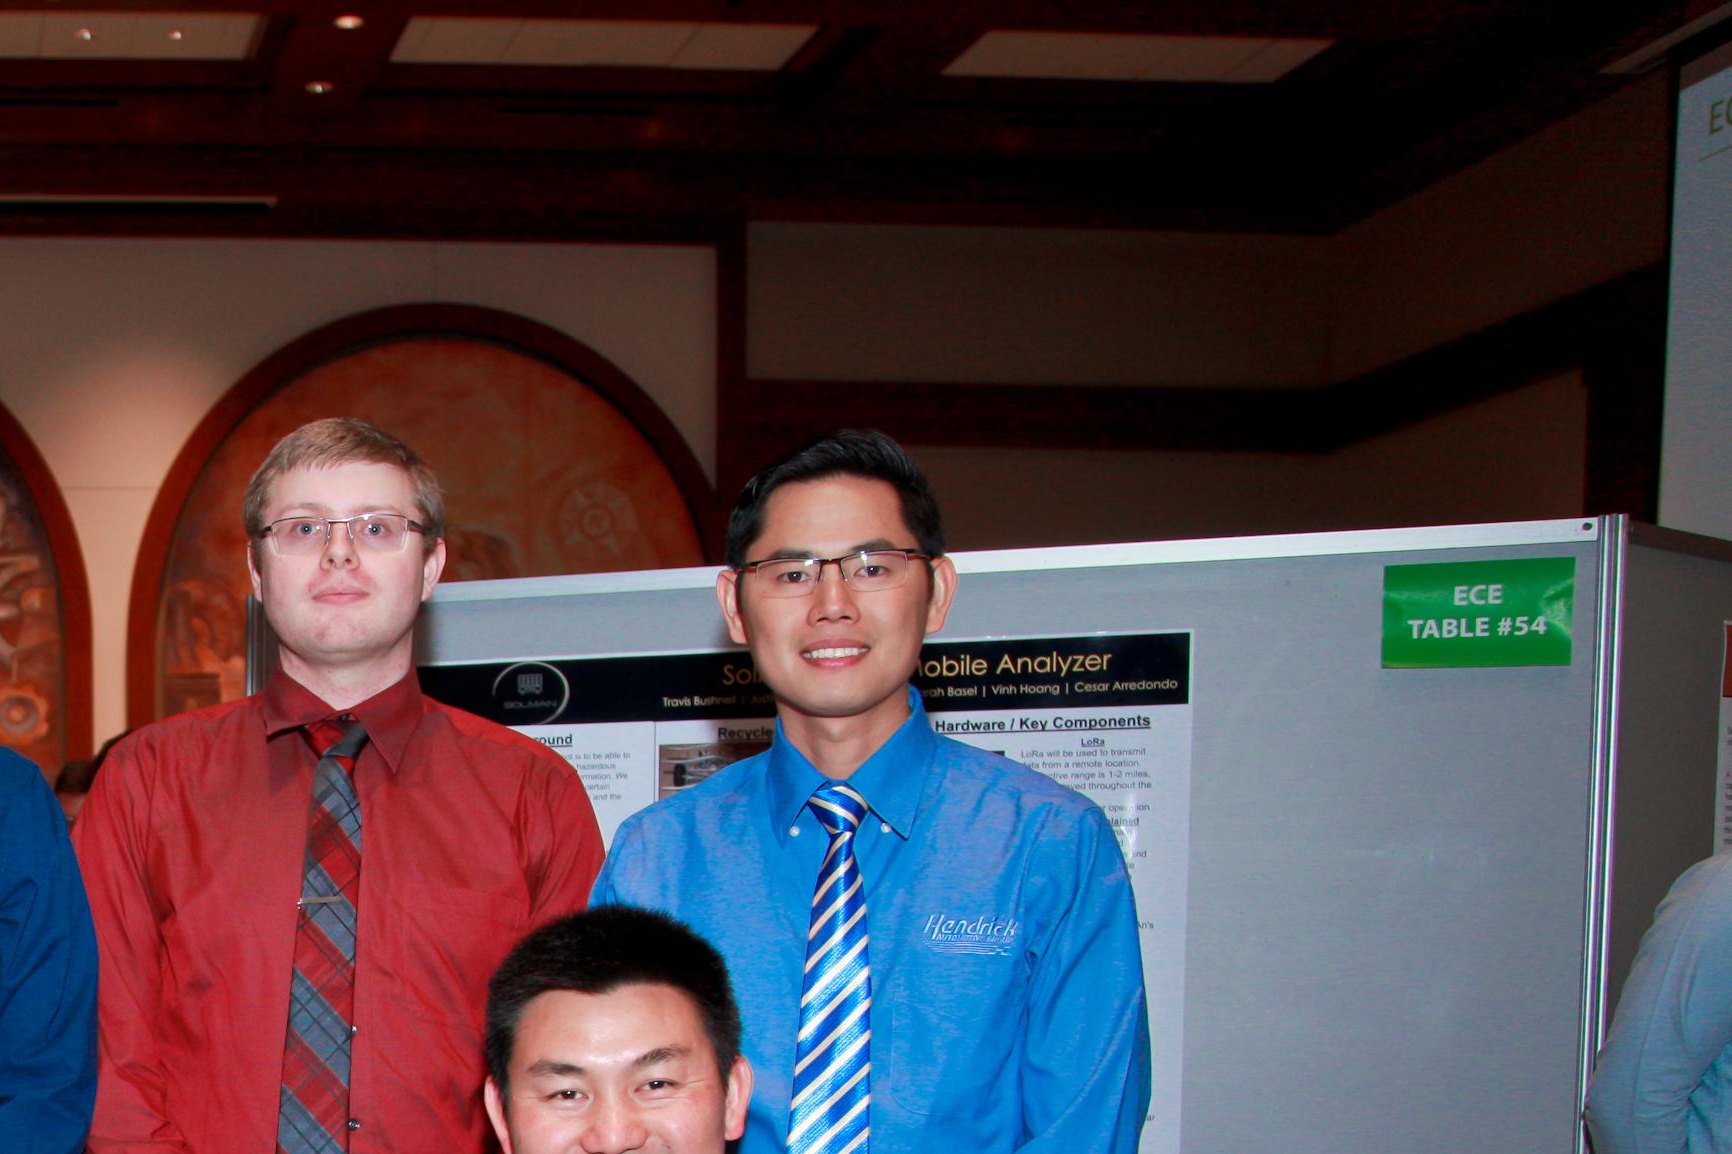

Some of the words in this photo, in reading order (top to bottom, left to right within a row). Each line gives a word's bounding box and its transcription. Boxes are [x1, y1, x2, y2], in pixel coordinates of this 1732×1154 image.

[1453, 584, 1504, 606] ECE
[1407, 618, 1490, 639] TABLE
[1497, 615, 1547, 636] #54
[995, 650, 1112, 677] Analyzer
[661, 696, 691, 708] Travis
[947, 685, 978, 697] Basel
[991, 684, 1017, 696] Vinh
[1019, 683, 1060, 696] Hoang
[1074, 681, 1110, 693] Cesar
[1112, 678, 1178, 692] Arredondo
[935, 719, 1006, 732] Hardware
[1019, 717, 1047, 731] Key
[1053, 715, 1151, 729] Components
[1080, 737, 1106, 747] LoRa
[1021, 750, 1044, 759] LoRa
[1046, 750, 1060, 758] will
[1063, 749, 1073, 758] be
[1076, 749, 1097, 757] used
[1099, 749, 1109, 757] to
[1110, 748, 1146, 756] transmit
[1042, 760, 1062, 769] from
[1072, 760, 1102, 768] remote
[1070, 772, 1095, 781] range
[1098, 770, 1105, 779] is
[1109, 770, 1123, 779] 1-2
[1088, 781, 1136, 790] throughout
[1138, 781, 1152, 789] the
[1110, 816, 1140, 826] lained
[923, 914, 1018, 940] Hendrick
